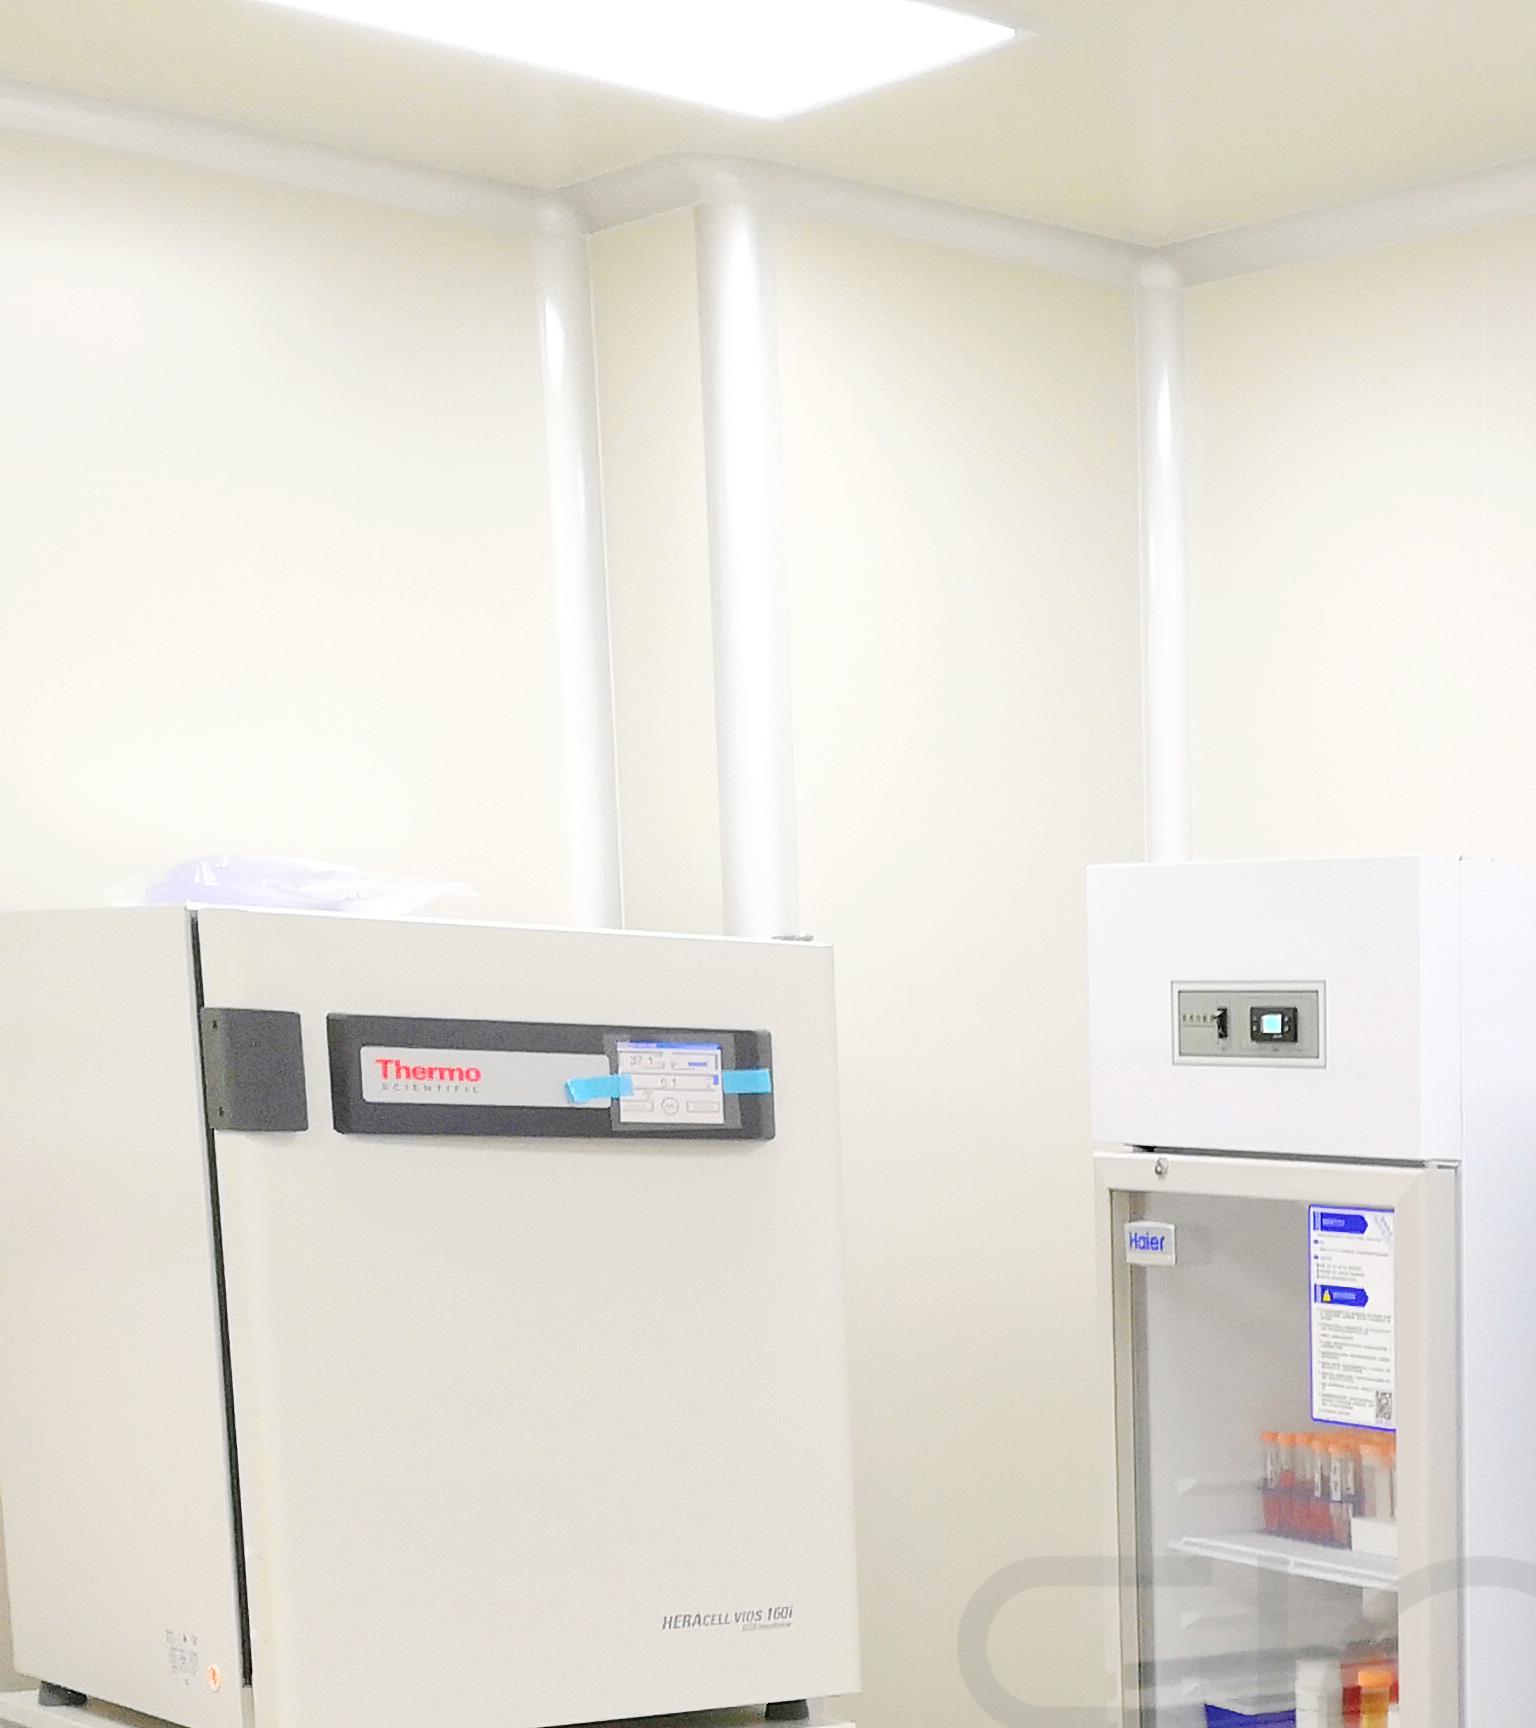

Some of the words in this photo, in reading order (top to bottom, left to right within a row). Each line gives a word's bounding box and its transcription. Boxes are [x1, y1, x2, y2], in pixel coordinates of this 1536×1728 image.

[375, 1058, 481, 1083] Thermo
[381, 1083, 480, 1093] SCIENTIFIC
[1128, 1231, 1165, 1251] Haier
[662, 1612, 730, 1630] HERACELL
[734, 1608, 763, 1624] VIOS
